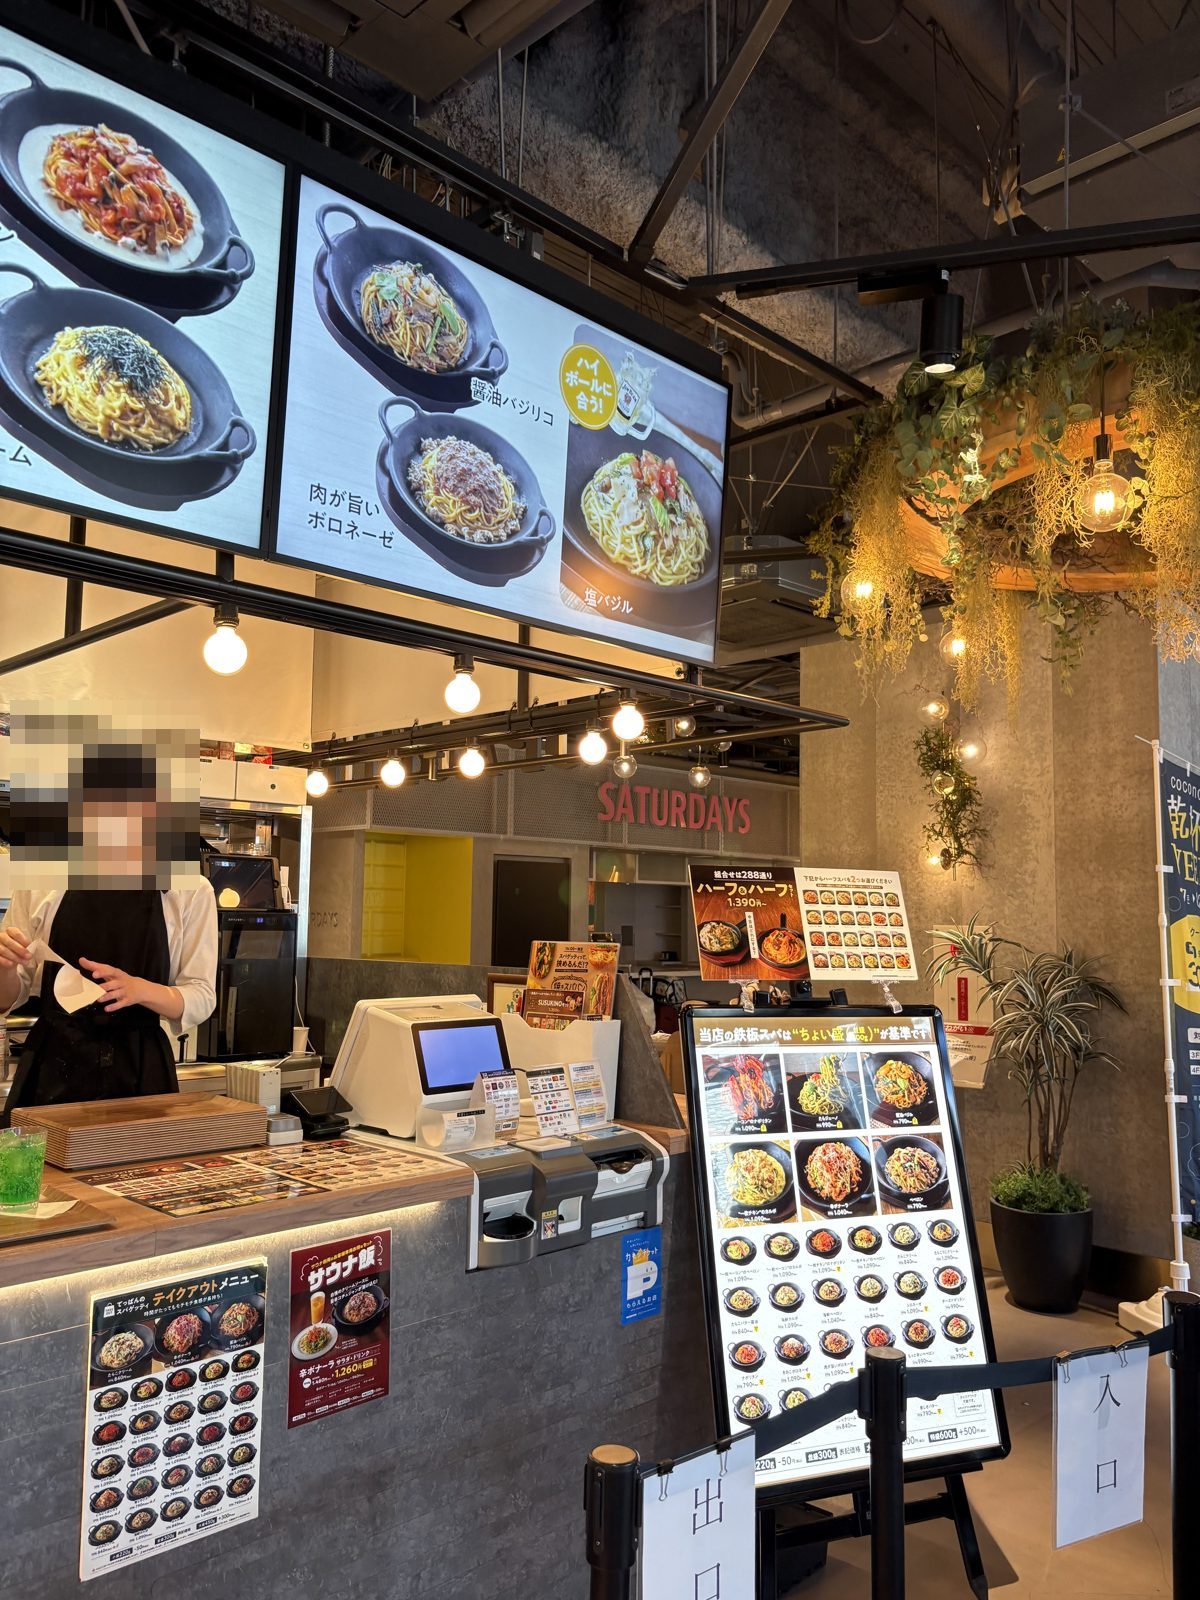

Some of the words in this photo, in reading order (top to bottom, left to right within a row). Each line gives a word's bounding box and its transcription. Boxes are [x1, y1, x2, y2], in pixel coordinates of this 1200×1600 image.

[577, 358, 600, 376] ハイ
[566, 370, 612, 396] ボールに
[472, 379, 553, 426] 醤油バジリコ
[309, 483, 379, 516] 肉が旨い
[308, 511, 394, 549] ボロネーゼ
[584, 587, 633, 614] 塩バジル
[597, 781, 751, 834] SATURDAYS
[714, 870, 773, 880] 組合せは288通り
[308, 1245, 376, 1292] サウナ飯
[116, 1295, 146, 1306] てっぱんの
[116, 1302, 149, 1316] スパゲッティ
[299, 1360, 335, 1378] 辛ボナーラ
[1093, 1374, 1121, 1493] 入口
[693, 1478, 723, 1600] 出口
